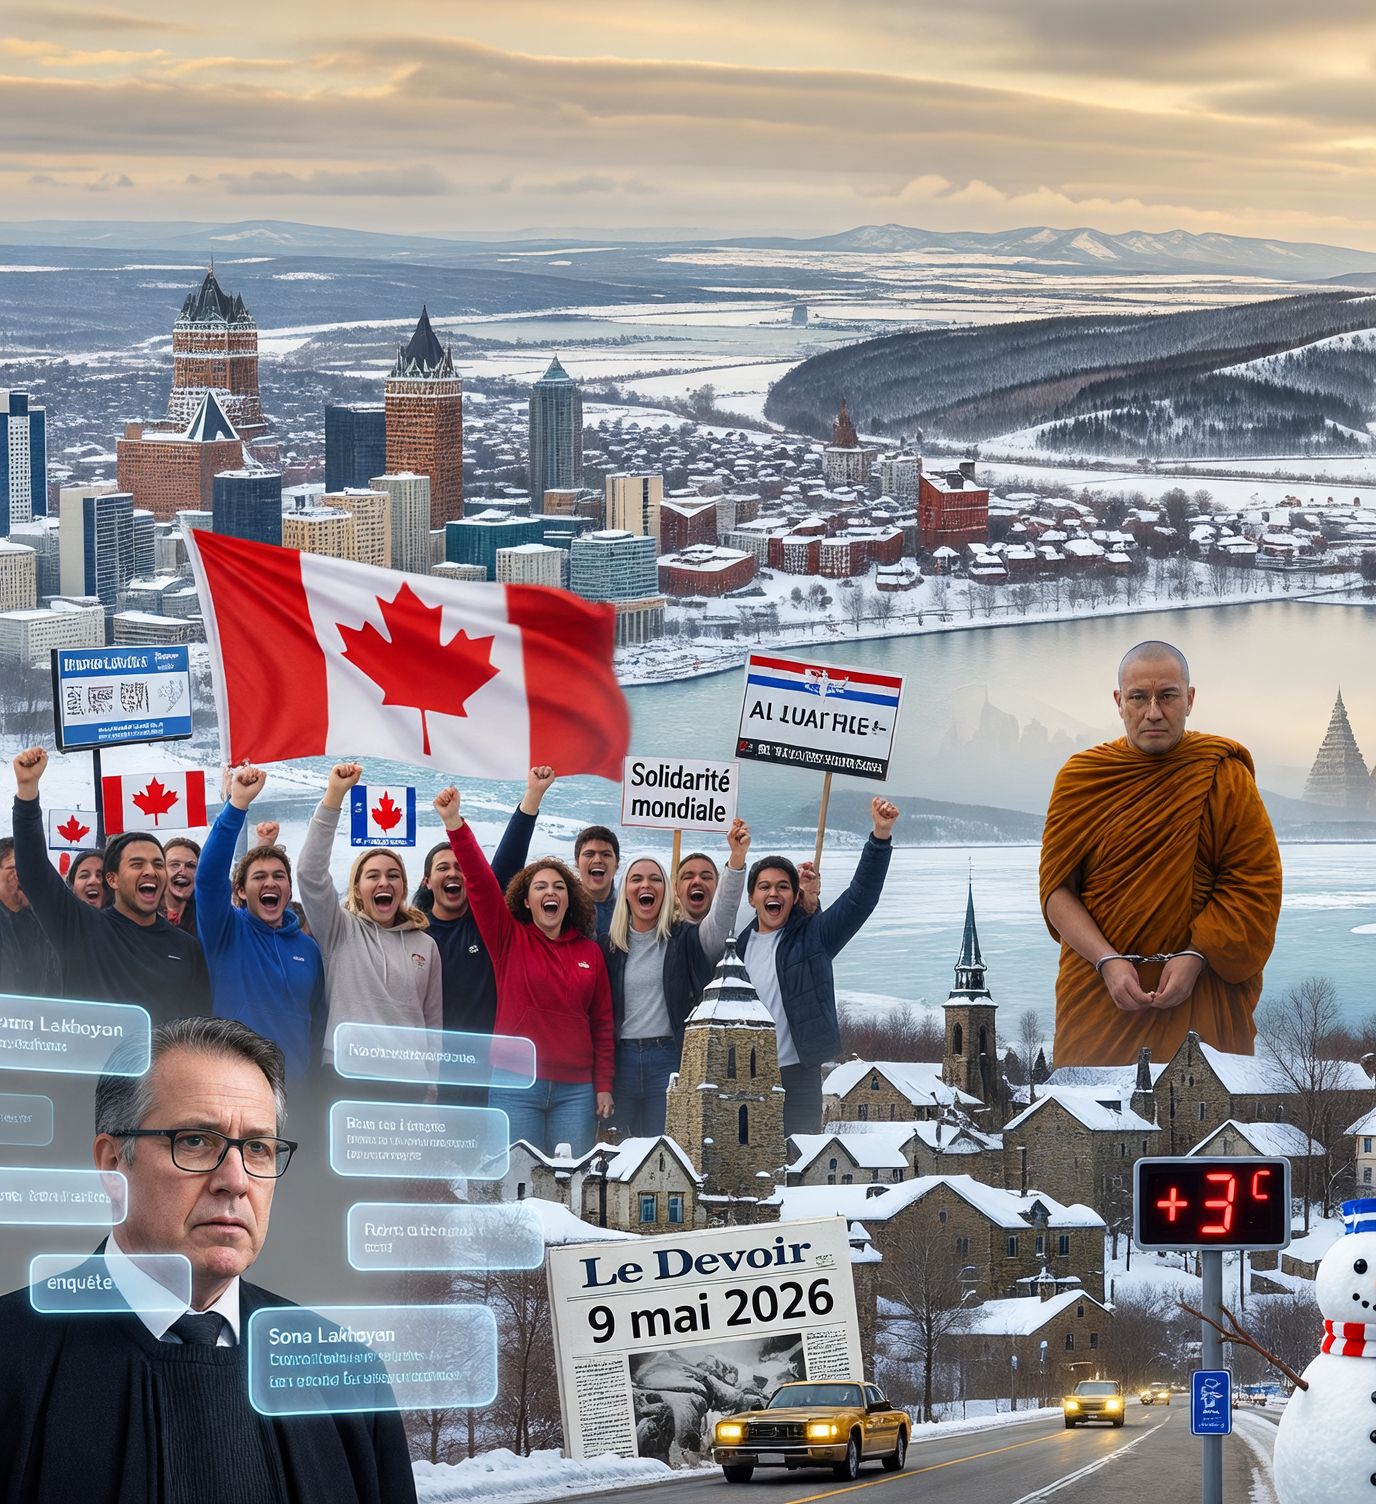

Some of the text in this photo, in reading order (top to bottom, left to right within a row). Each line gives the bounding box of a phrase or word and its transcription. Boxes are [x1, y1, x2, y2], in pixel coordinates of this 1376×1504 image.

[631, 762, 730, 793] Solidarité
[631, 797, 726, 822] mondiale
[579, 1236, 812, 1288] Le Devoir
[588, 1278, 834, 1343] 9 mai 2026
[269, 1328, 312, 1345] Sona
